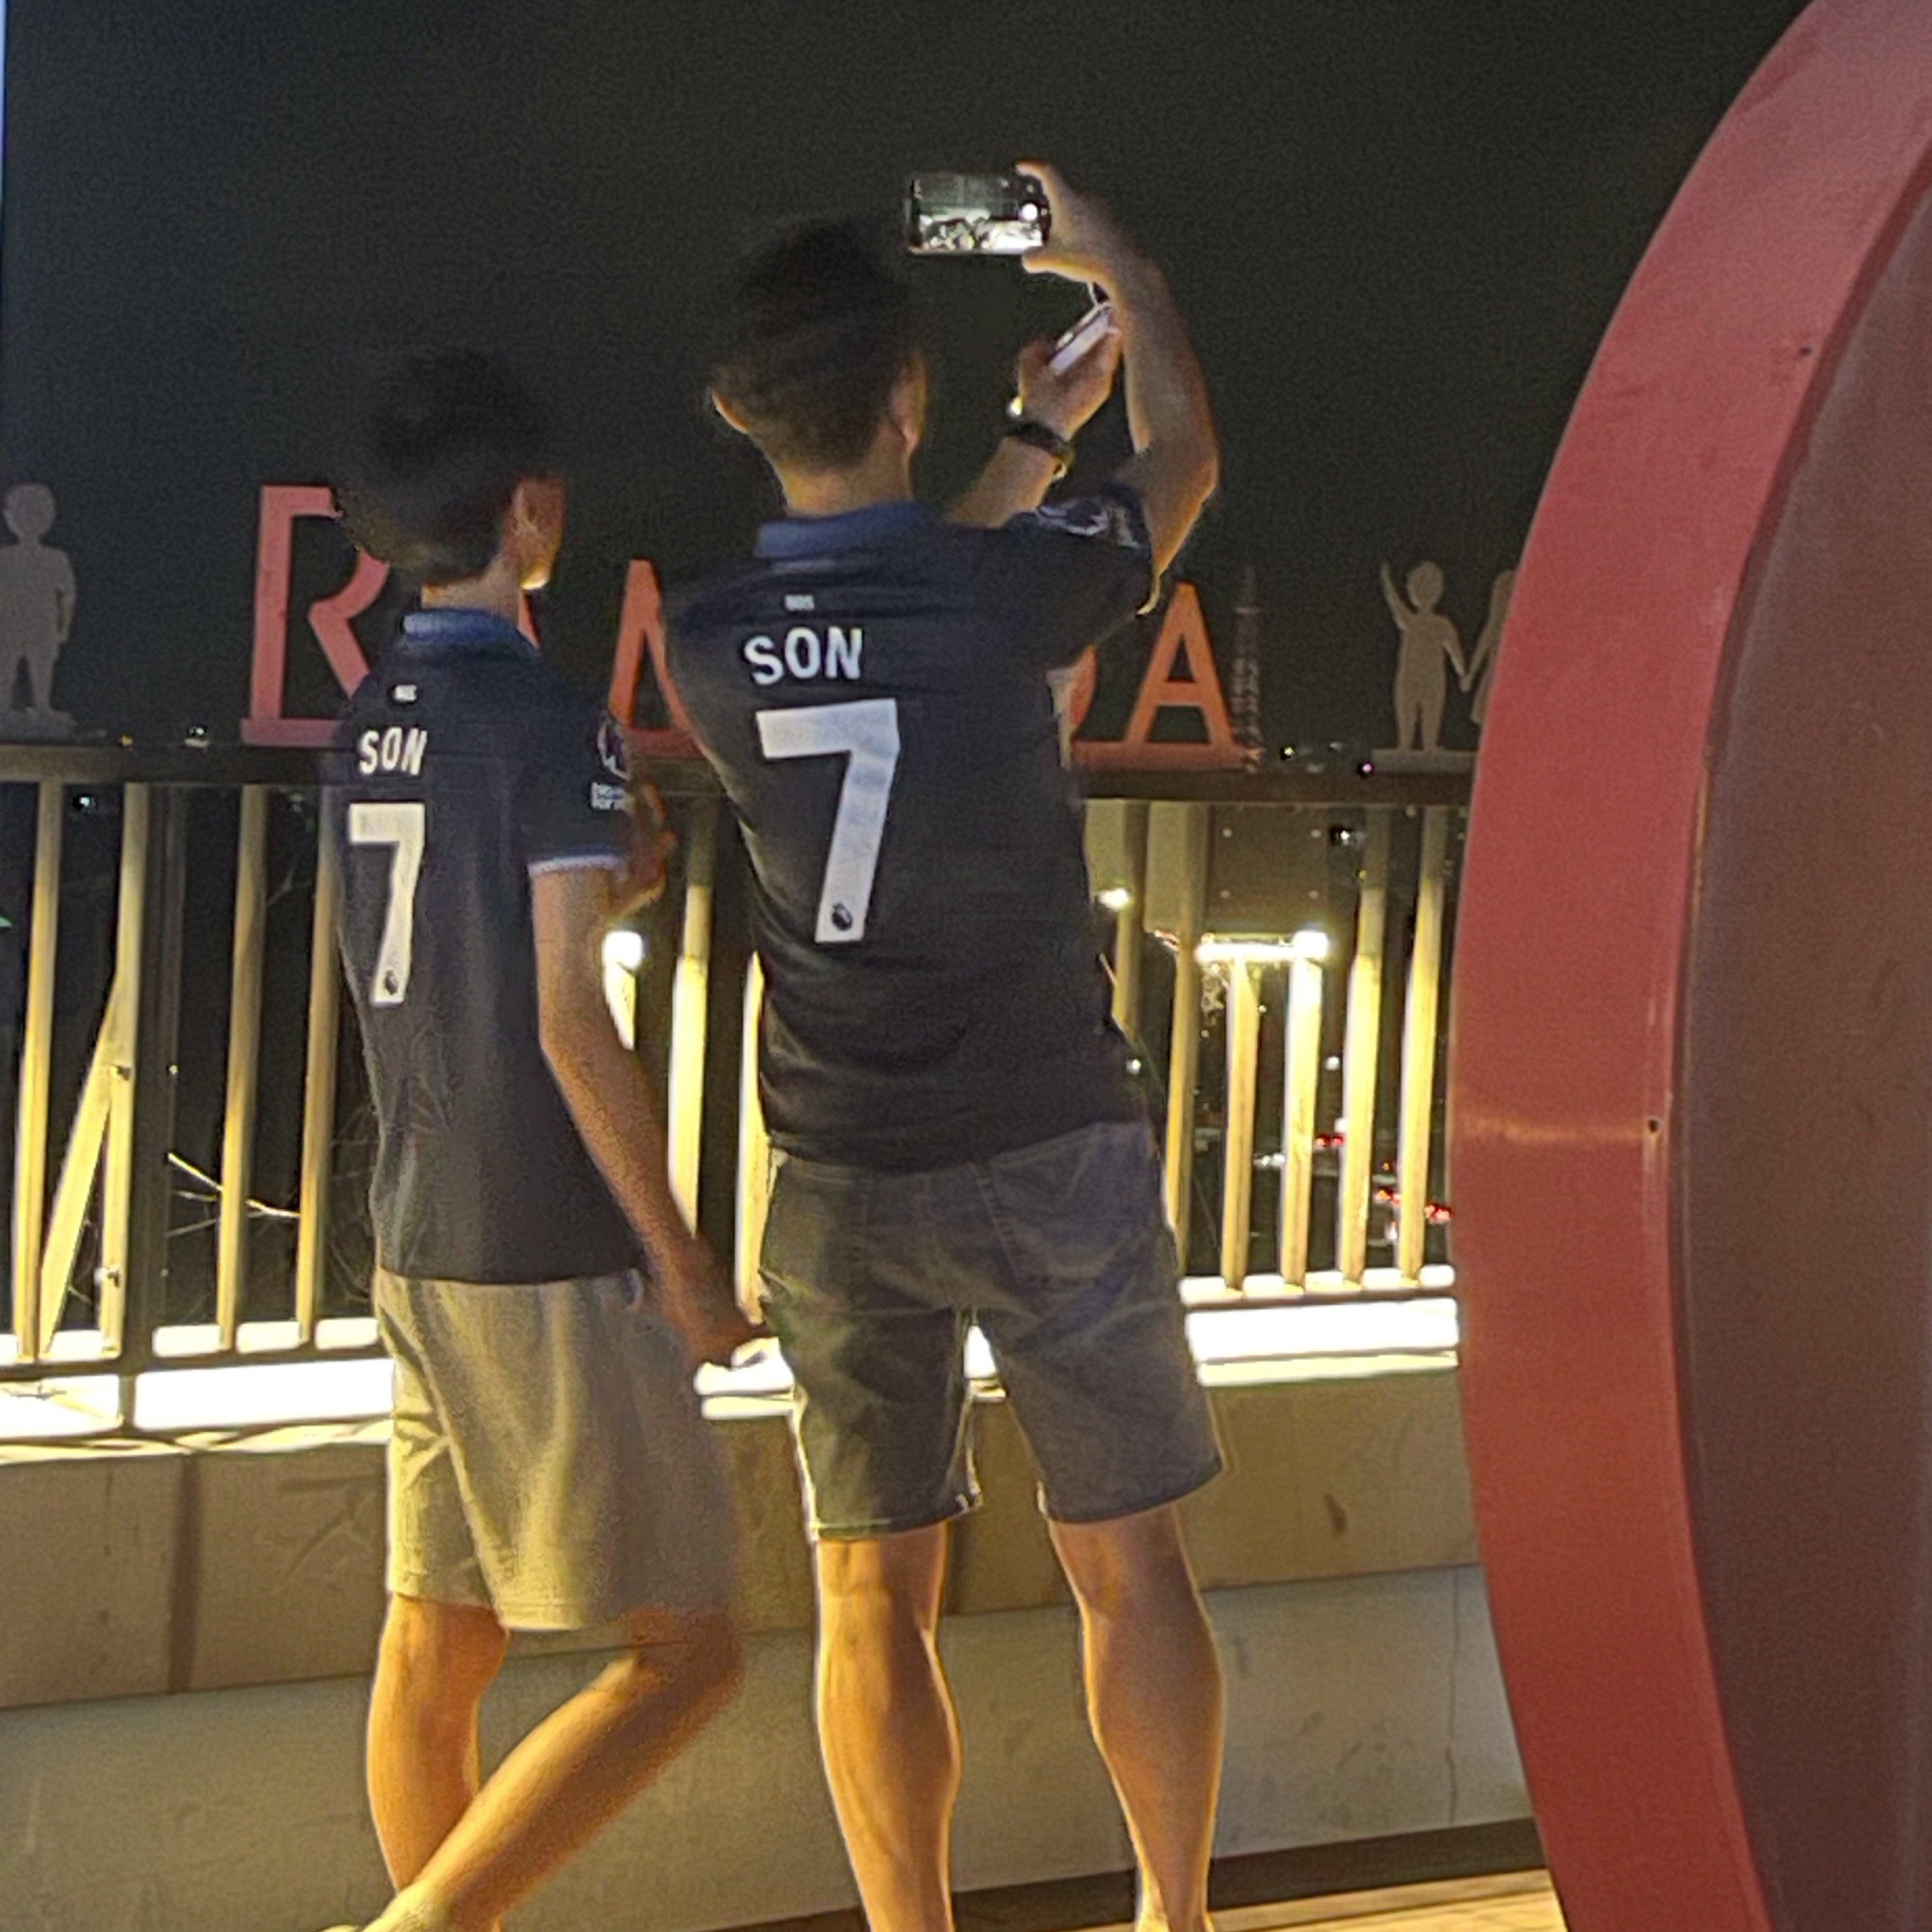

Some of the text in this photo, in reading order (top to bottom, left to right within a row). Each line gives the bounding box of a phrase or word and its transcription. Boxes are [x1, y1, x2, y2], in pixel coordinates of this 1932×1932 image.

[744, 626, 862, 685] SON
[358, 726, 427, 775] SON
[756, 698, 900, 944] 7
[349, 802, 425, 1007] 7
